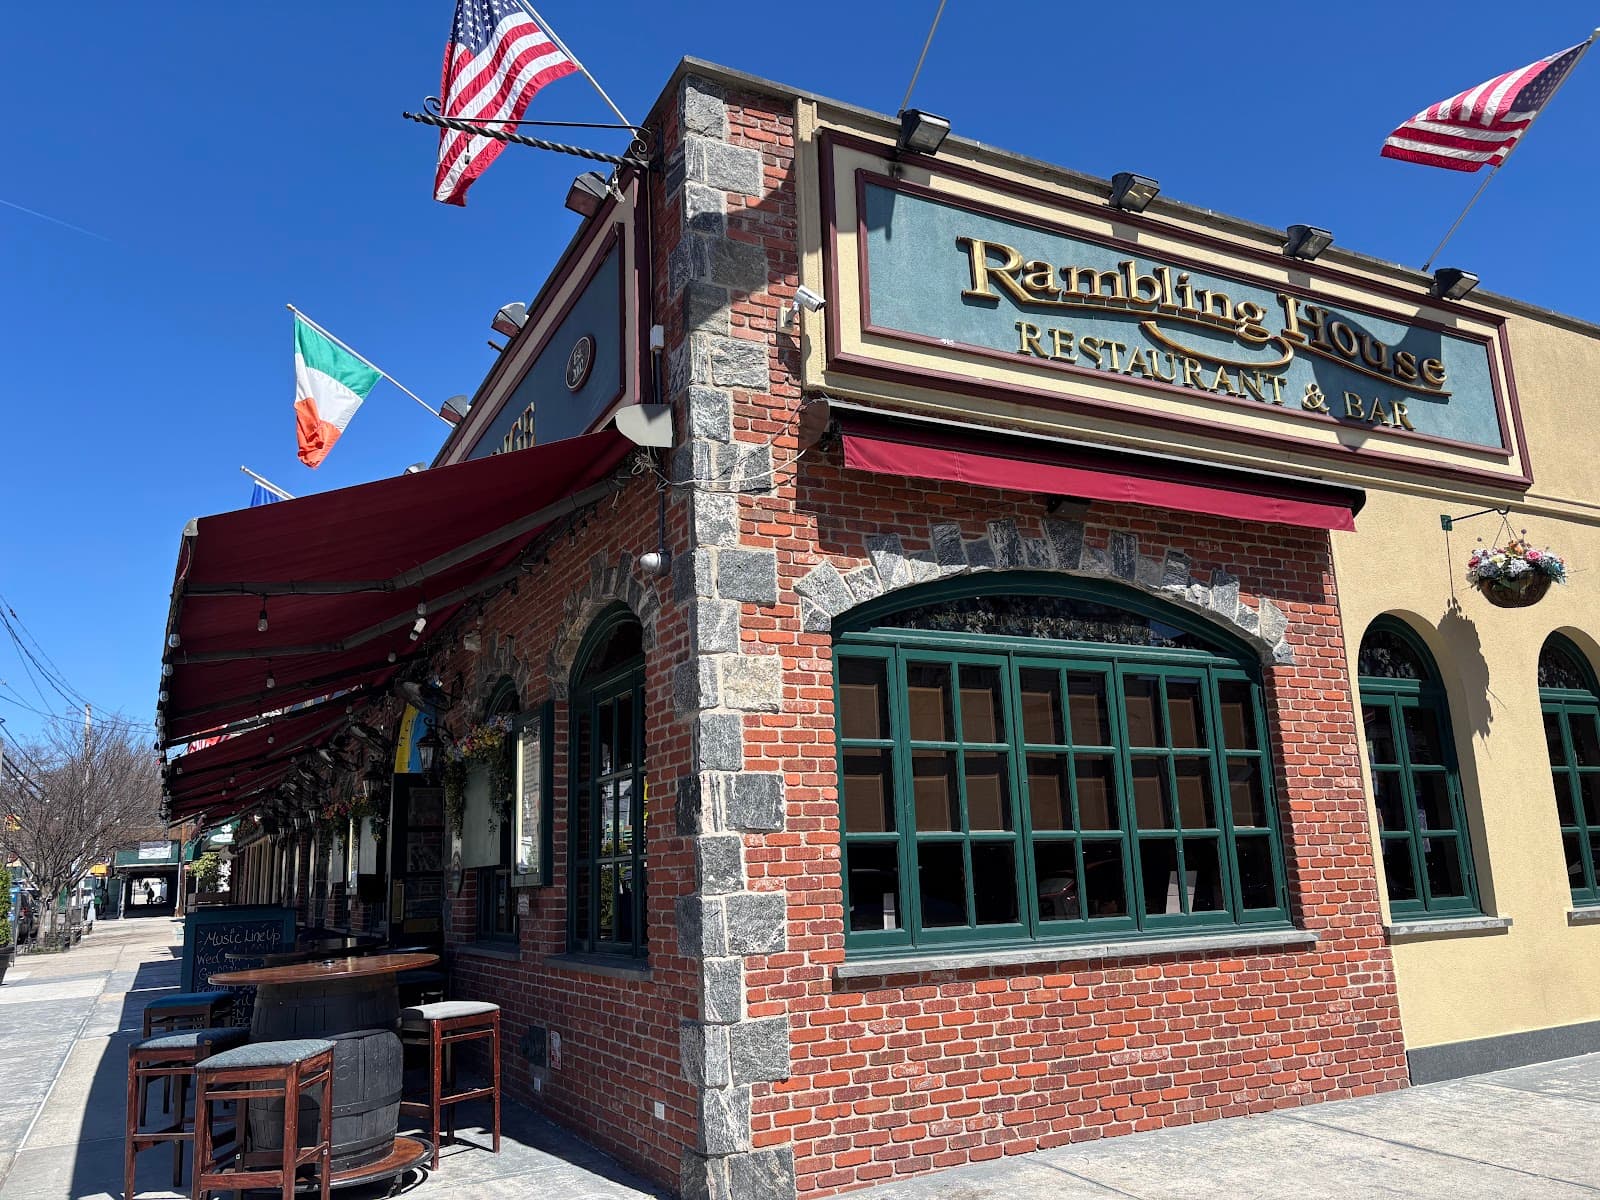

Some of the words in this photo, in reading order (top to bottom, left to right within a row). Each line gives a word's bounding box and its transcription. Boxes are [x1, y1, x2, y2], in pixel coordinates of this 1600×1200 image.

[957, 236, 1272, 346] Rambling
[1277, 292, 1448, 387] House
[1015, 321, 1287, 405] RESTAURANT
[1302, 383, 1330, 413] &
[1343, 391, 1416, 431] BAR
[204, 928, 242, 946] Music
